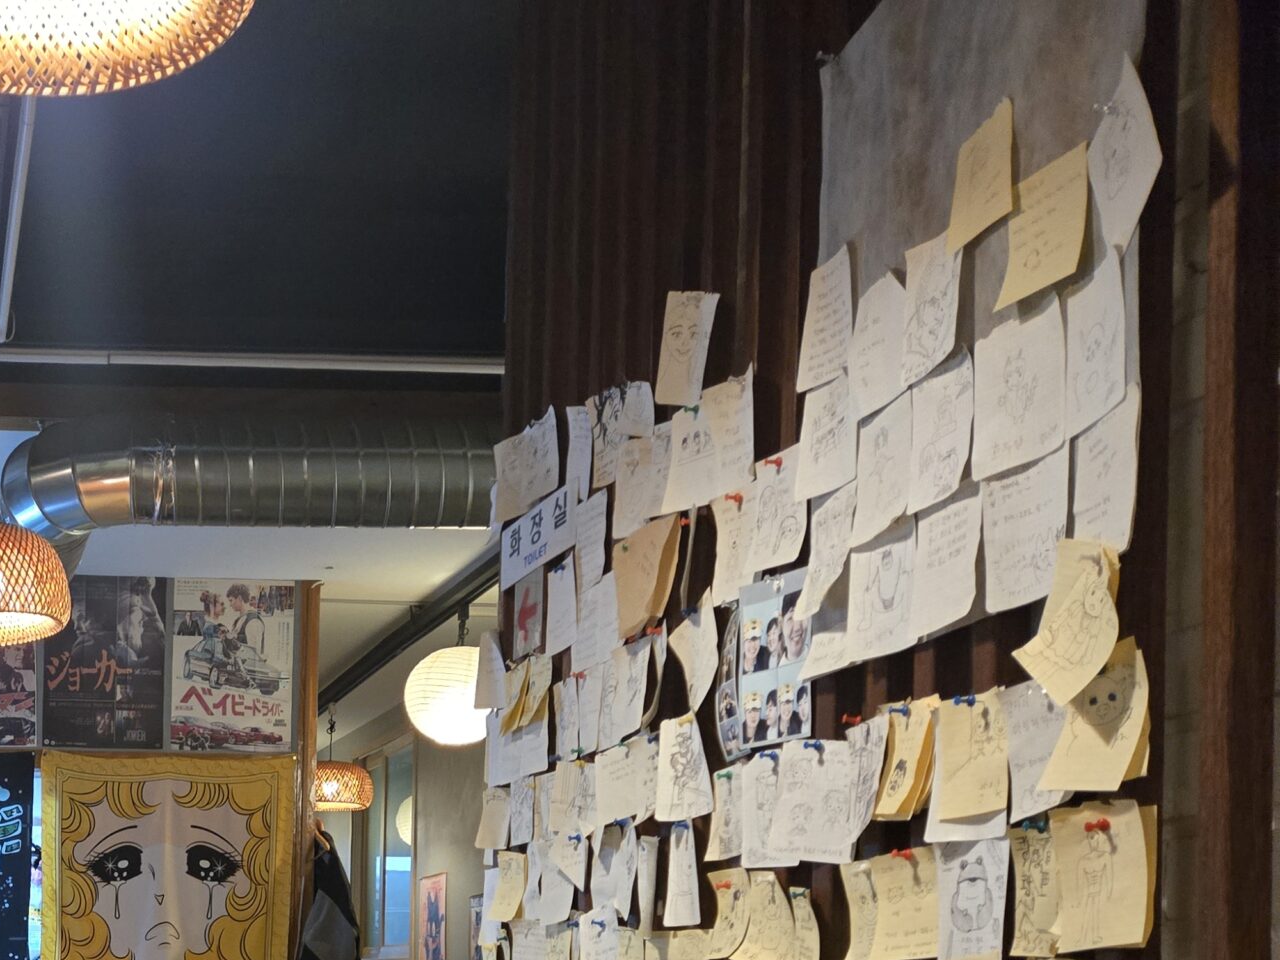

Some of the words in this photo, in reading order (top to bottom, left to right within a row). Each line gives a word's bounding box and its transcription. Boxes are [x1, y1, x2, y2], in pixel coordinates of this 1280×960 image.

[509, 491, 568, 559] 화장실
[523, 542, 548, 568] TOILET
[46, 650, 133, 692] ジョーカー
